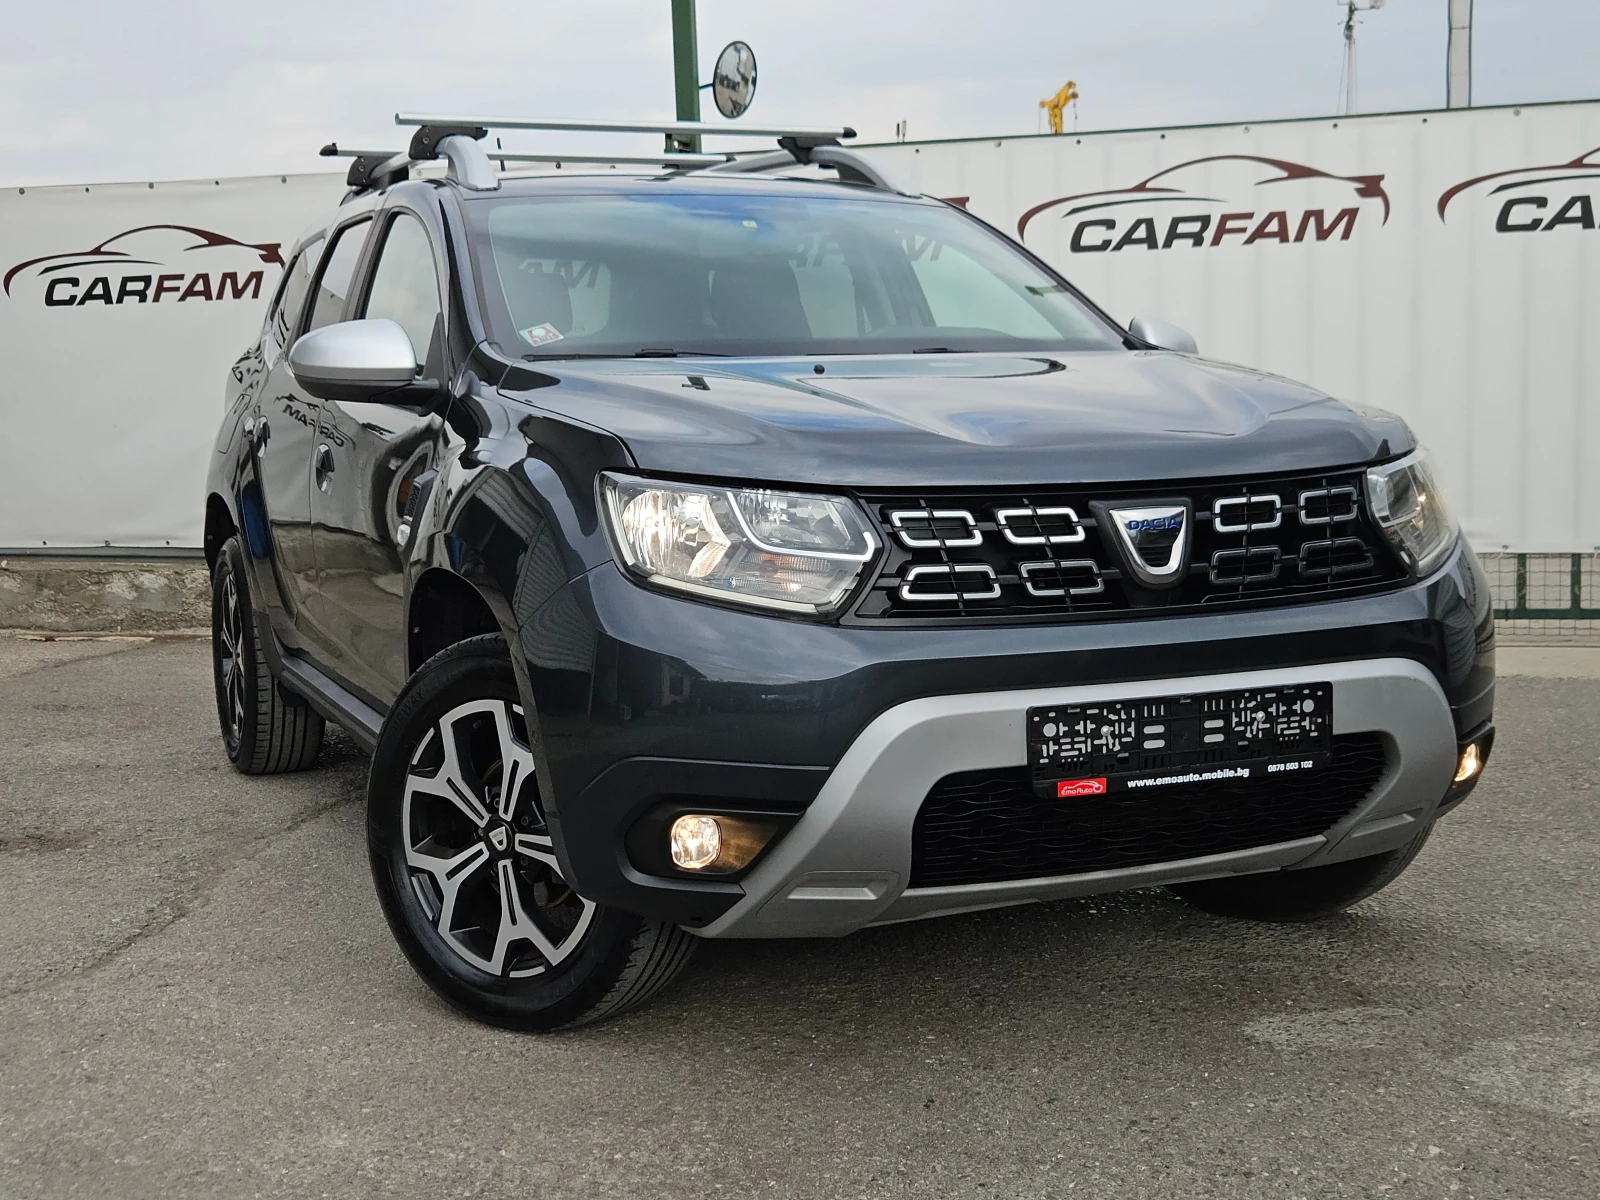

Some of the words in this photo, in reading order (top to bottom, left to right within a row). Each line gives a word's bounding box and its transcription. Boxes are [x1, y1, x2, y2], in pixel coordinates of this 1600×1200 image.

[1070, 207, 1360, 253] CARFAM
[1495, 195, 1600, 233] CA
[44, 271, 265, 307] CARFAM
[1128, 518, 1180, 531] DACIA
[1127, 767, 1250, 788] www.emoauto.mobile.bg
[1285, 762, 1299, 771] 503
[1300, 760, 1313, 769] 102
